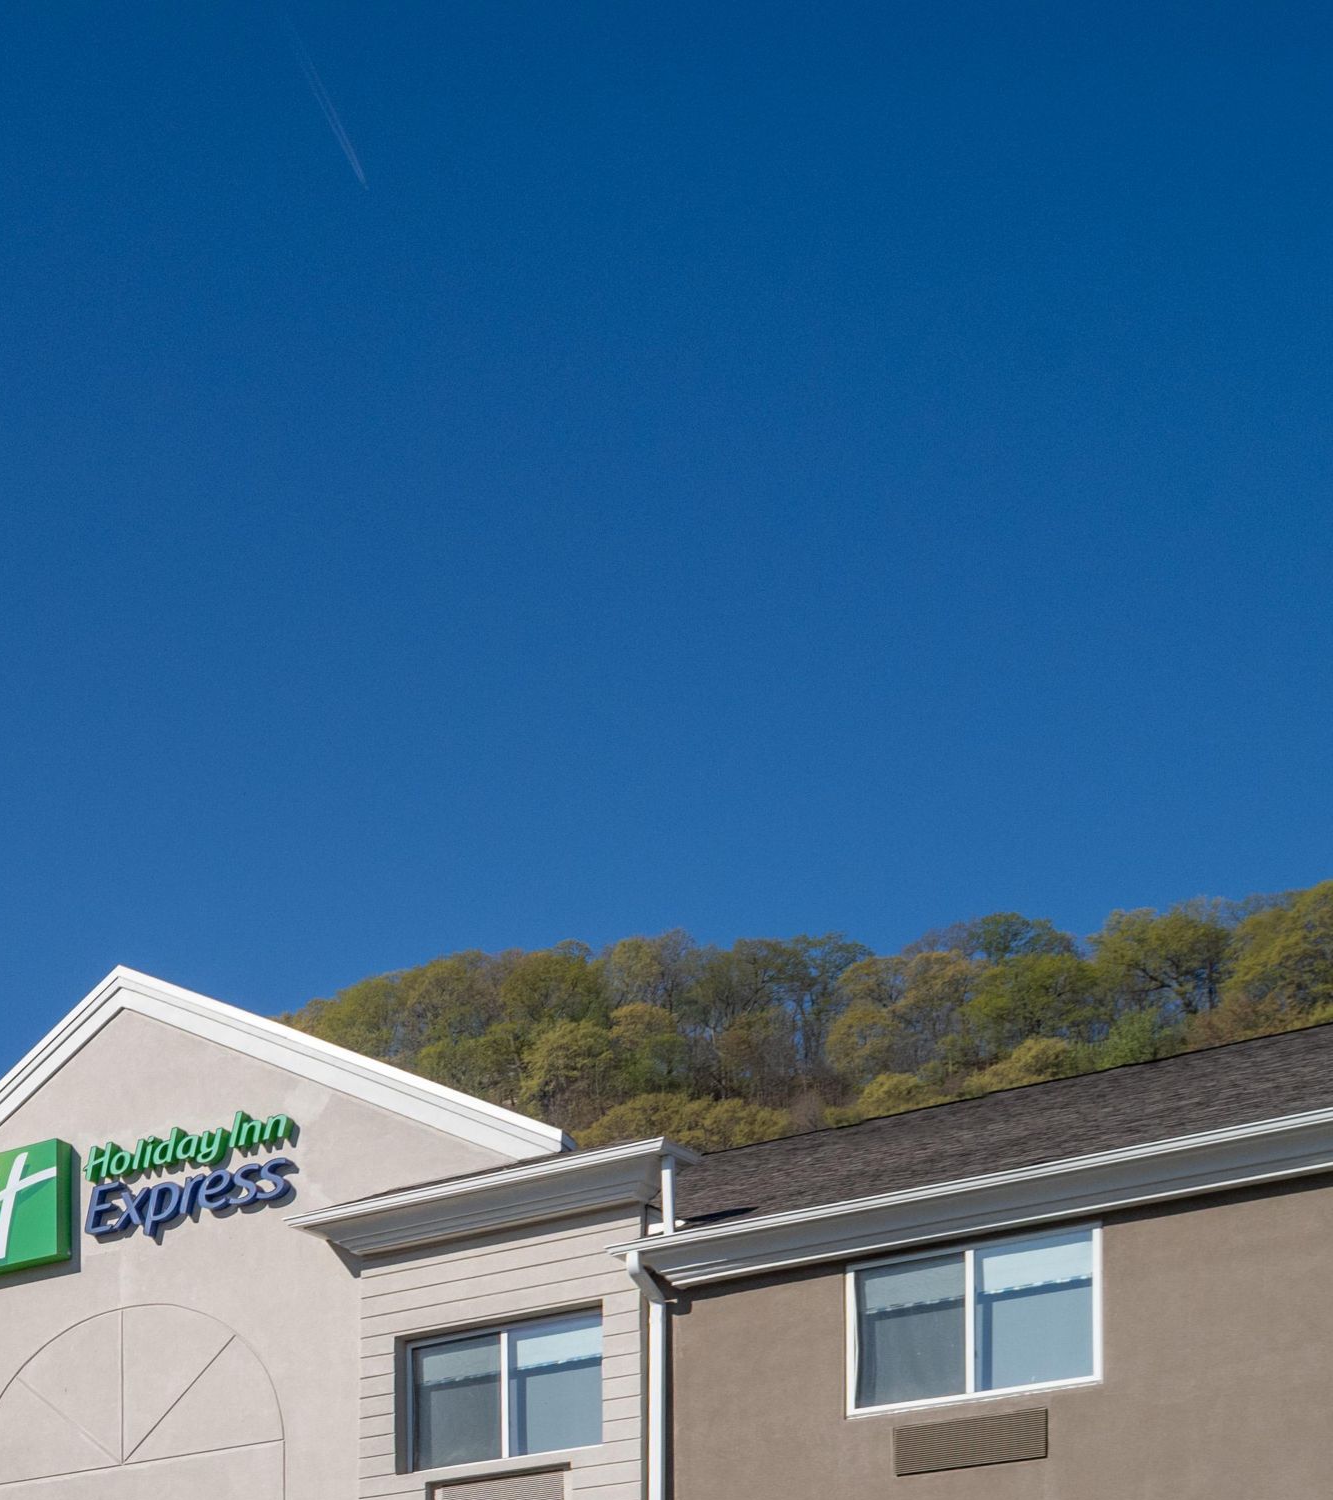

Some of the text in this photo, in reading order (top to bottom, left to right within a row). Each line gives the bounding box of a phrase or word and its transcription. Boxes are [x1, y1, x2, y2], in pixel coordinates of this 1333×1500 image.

[83, 1111, 294, 1181] Holiday Inn
[85, 1157, 292, 1237] Express
